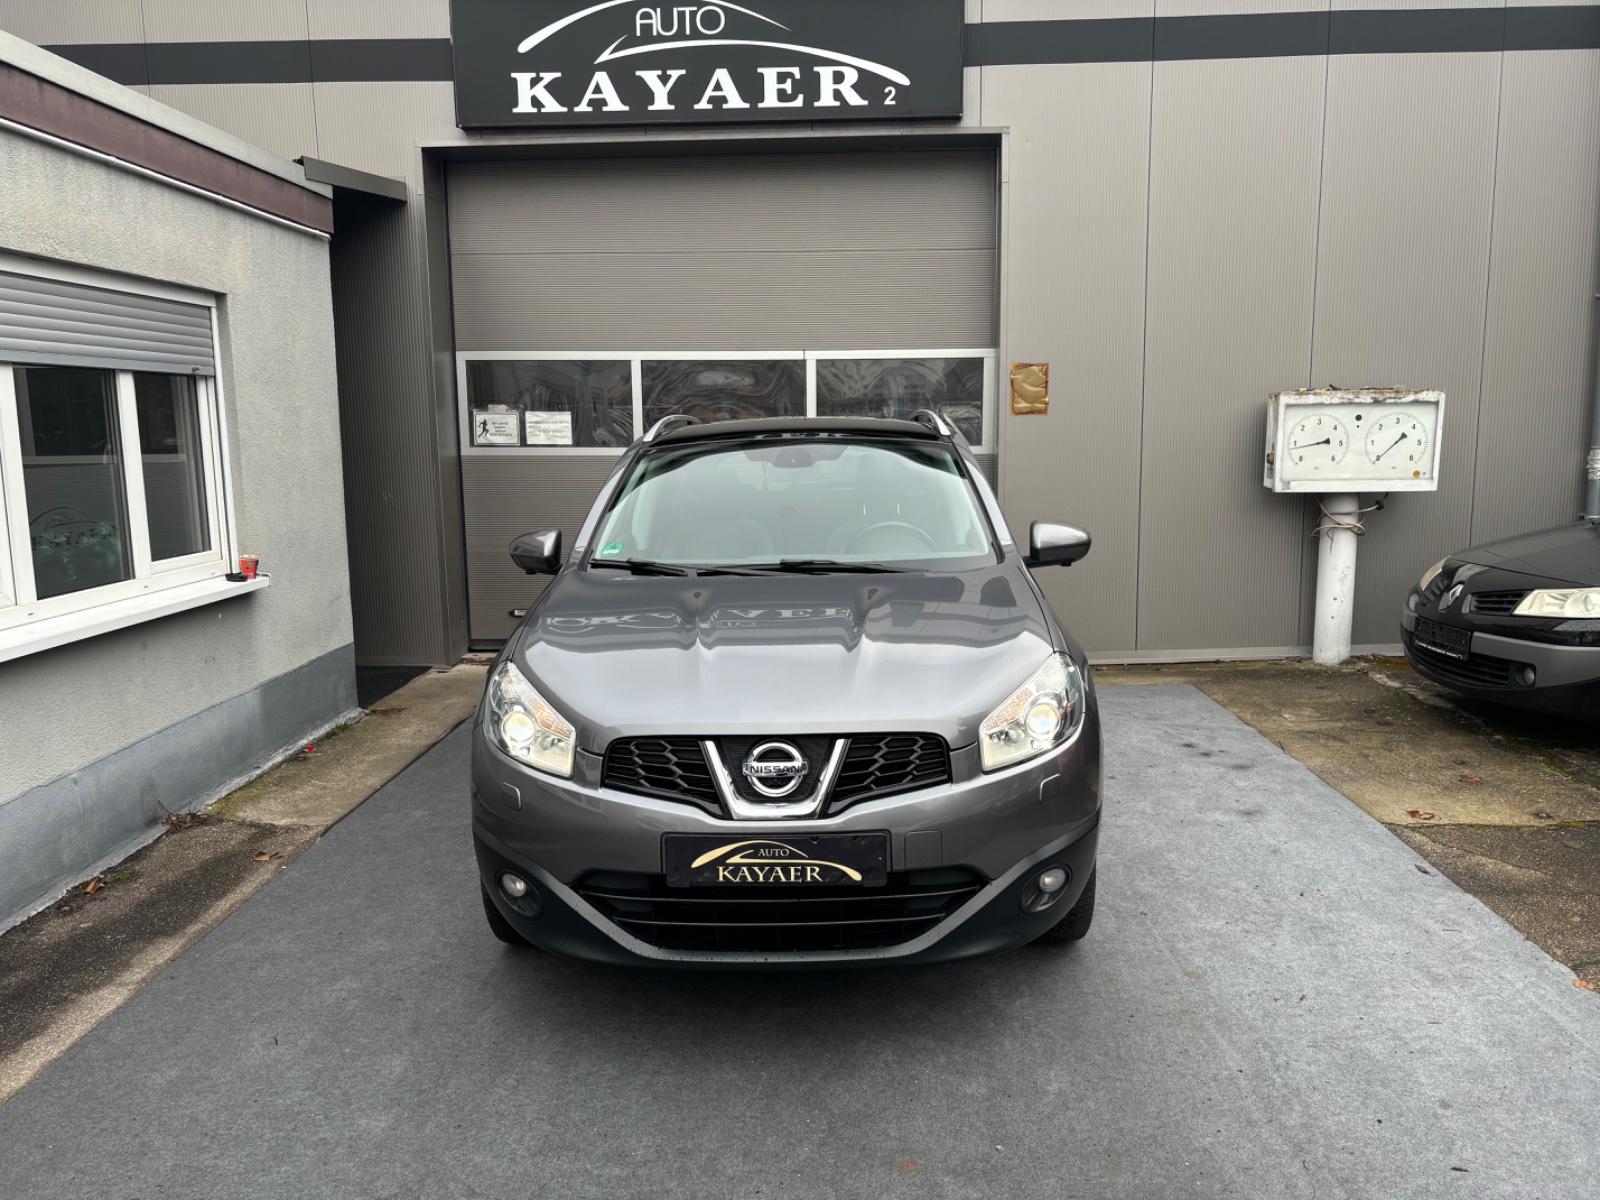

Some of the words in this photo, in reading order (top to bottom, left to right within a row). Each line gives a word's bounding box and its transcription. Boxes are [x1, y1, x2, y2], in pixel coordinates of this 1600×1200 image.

[635, 5, 726, 37] AUTO
[511, 65, 868, 113] KAYAER
[883, 86, 897, 105] 2
[1300, 424, 1305, 432] 2
[1317, 418, 1322, 426] 3
[1338, 439, 1343, 447] 5
[1378, 423, 1383, 431] 2
[1395, 416, 1400, 425] 3
[1416, 438, 1421, 446] 5
[750, 765, 800, 774] NISSAN
[758, 848, 790, 857] AUTO
[716, 866, 824, 883] KAYAER
